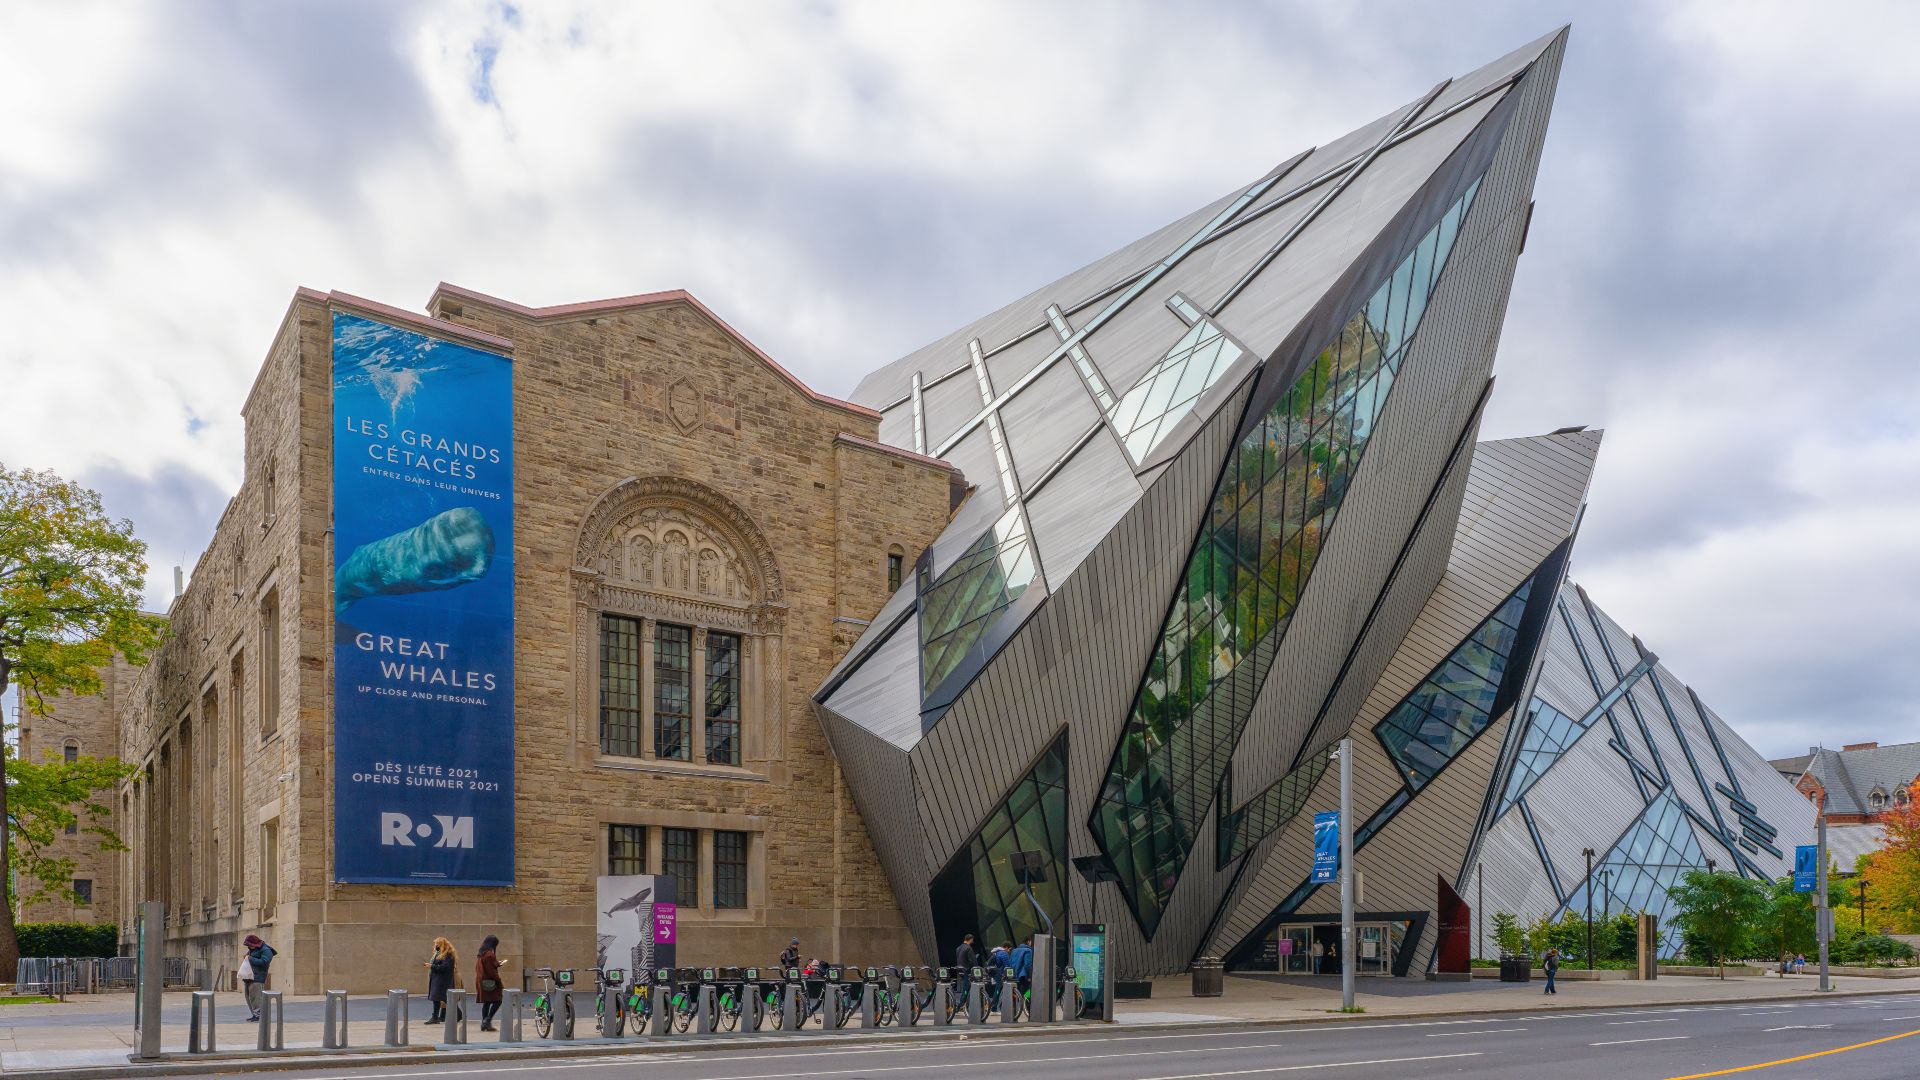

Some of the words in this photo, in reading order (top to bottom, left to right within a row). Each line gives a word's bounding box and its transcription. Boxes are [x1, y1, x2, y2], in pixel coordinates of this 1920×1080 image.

[347, 416, 389, 439] LES
[401, 429, 500, 464] GRANDS
[368, 444, 476, 480] CÉTACÉS
[363, 466, 401, 480] ENTREZ
[405, 475, 431, 486] DANS
[434, 481, 458, 492] LEUR
[461, 486, 501, 500] UNIVERS
[355, 632, 449, 660] GREAT
[380, 660, 496, 691] WHALES
[358, 685, 372, 693] UP
[375, 687, 408, 698] CLOSE
[411, 691, 433, 701] AND
[436, 693, 488, 706] PERSONAL
[352, 772, 400, 785] OPENS
[405, 776, 464, 789] SUMMER
[469, 780, 499, 791] 2021
[375, 761, 402, 773] DÈS
[448, 768, 478, 778] 2021
